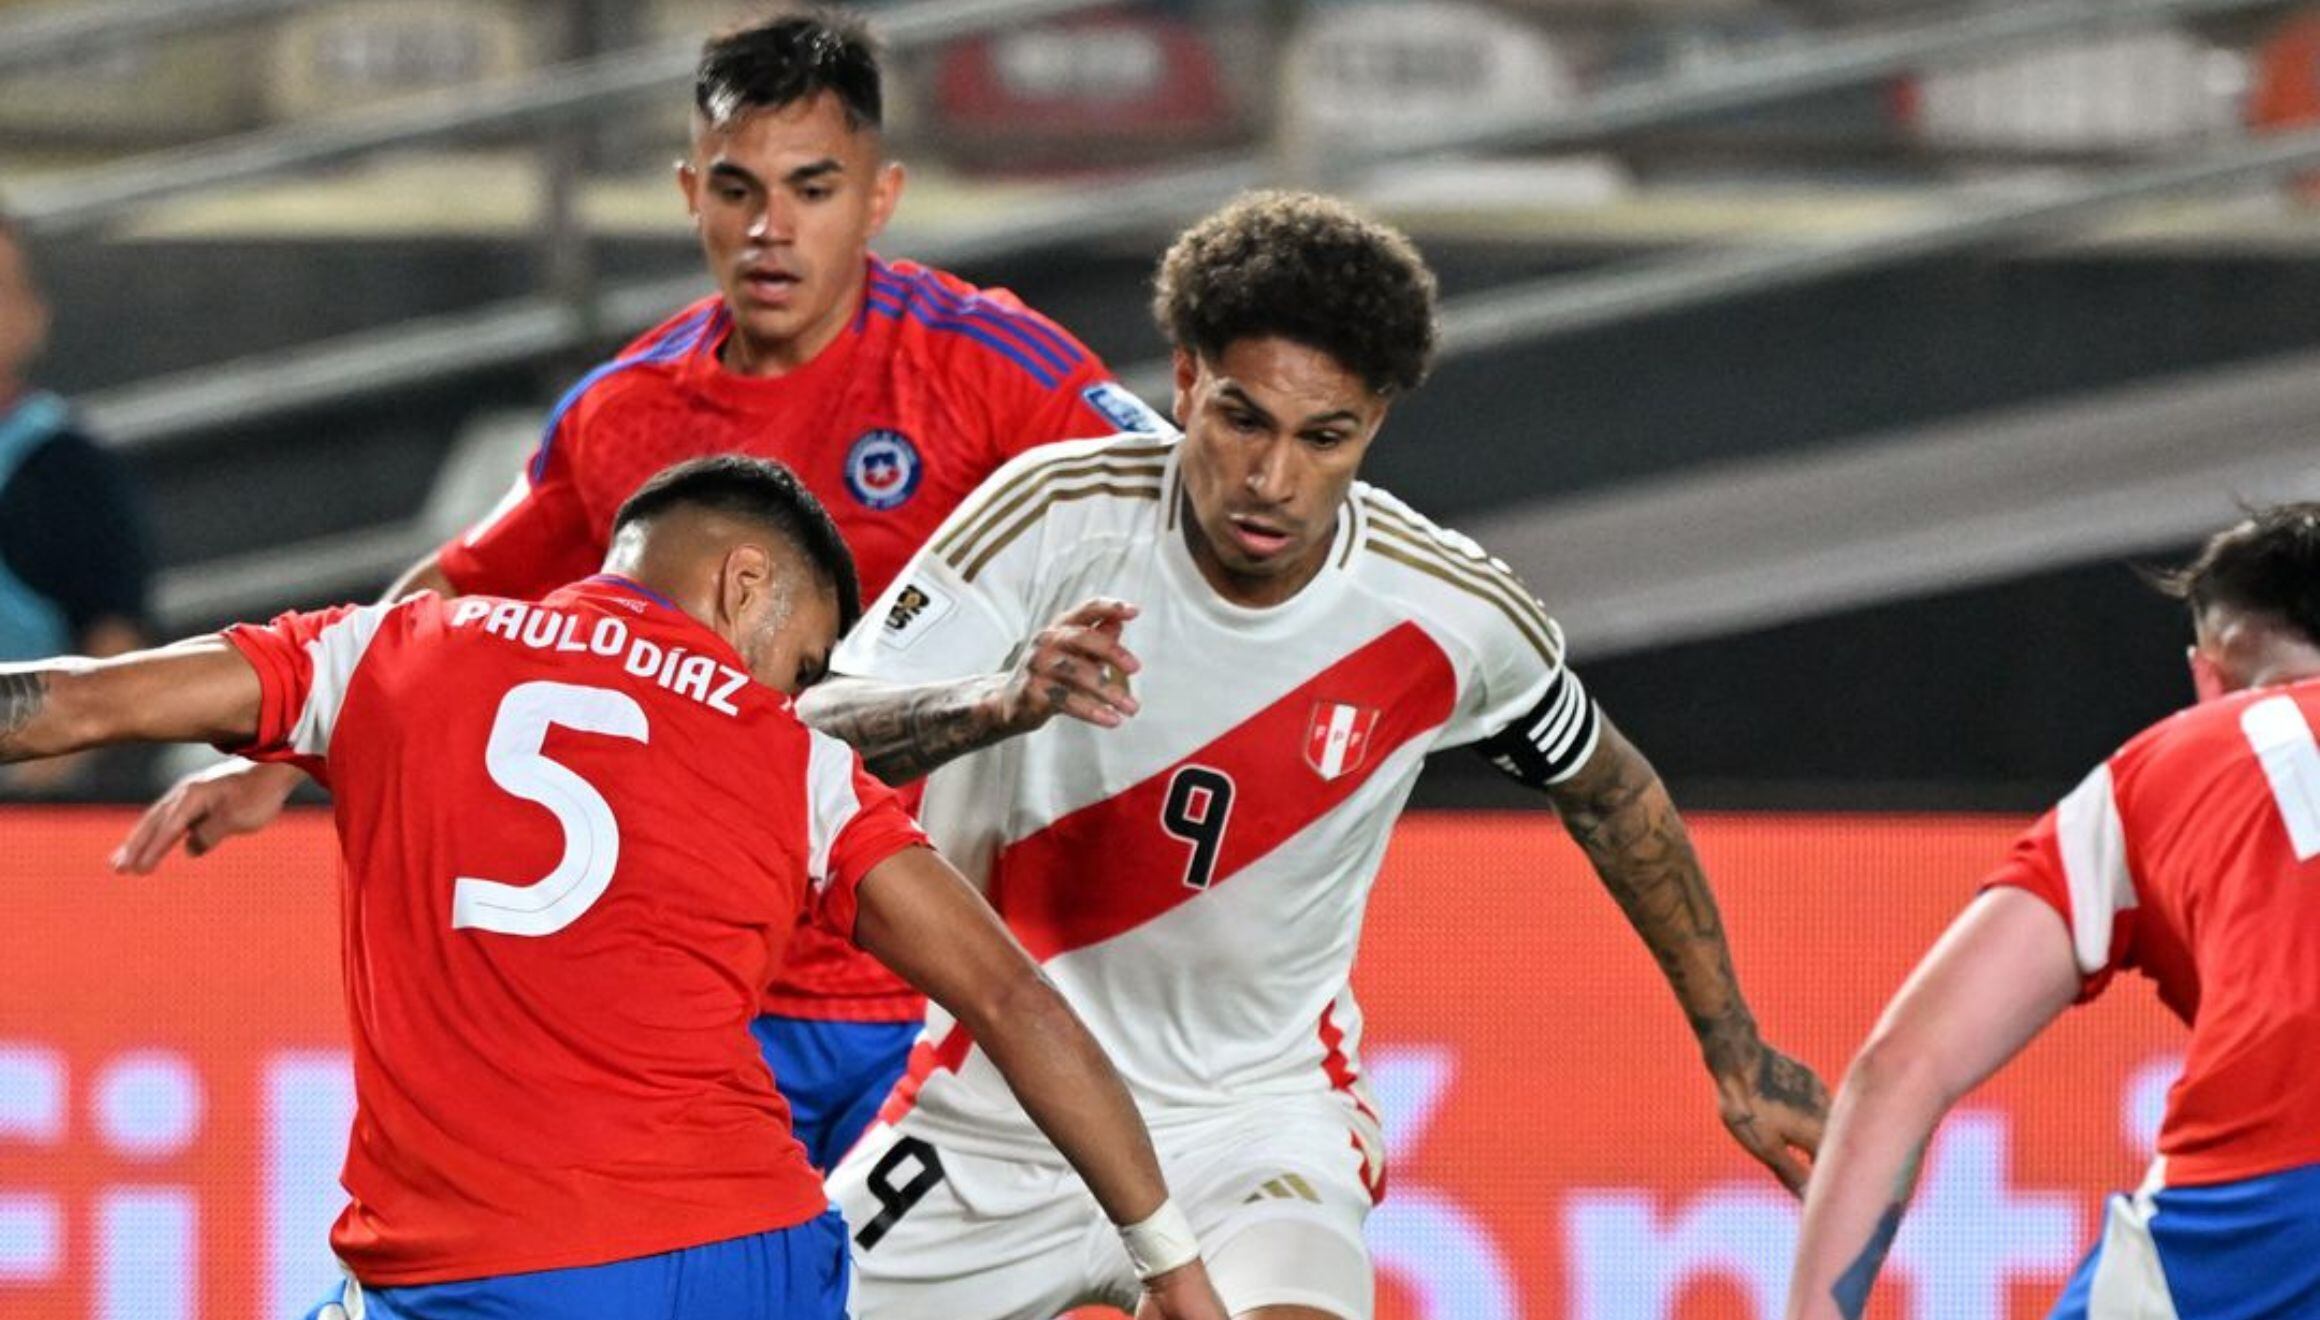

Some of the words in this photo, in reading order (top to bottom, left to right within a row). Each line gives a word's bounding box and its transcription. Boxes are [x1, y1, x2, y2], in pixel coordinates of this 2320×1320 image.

[452, 600, 628, 656] PAULO
[625, 638, 750, 717] DÍAZ
[452, 680, 650, 938] 5
[1160, 763, 1236, 890] 9
[855, 1134, 946, 1252] 9
